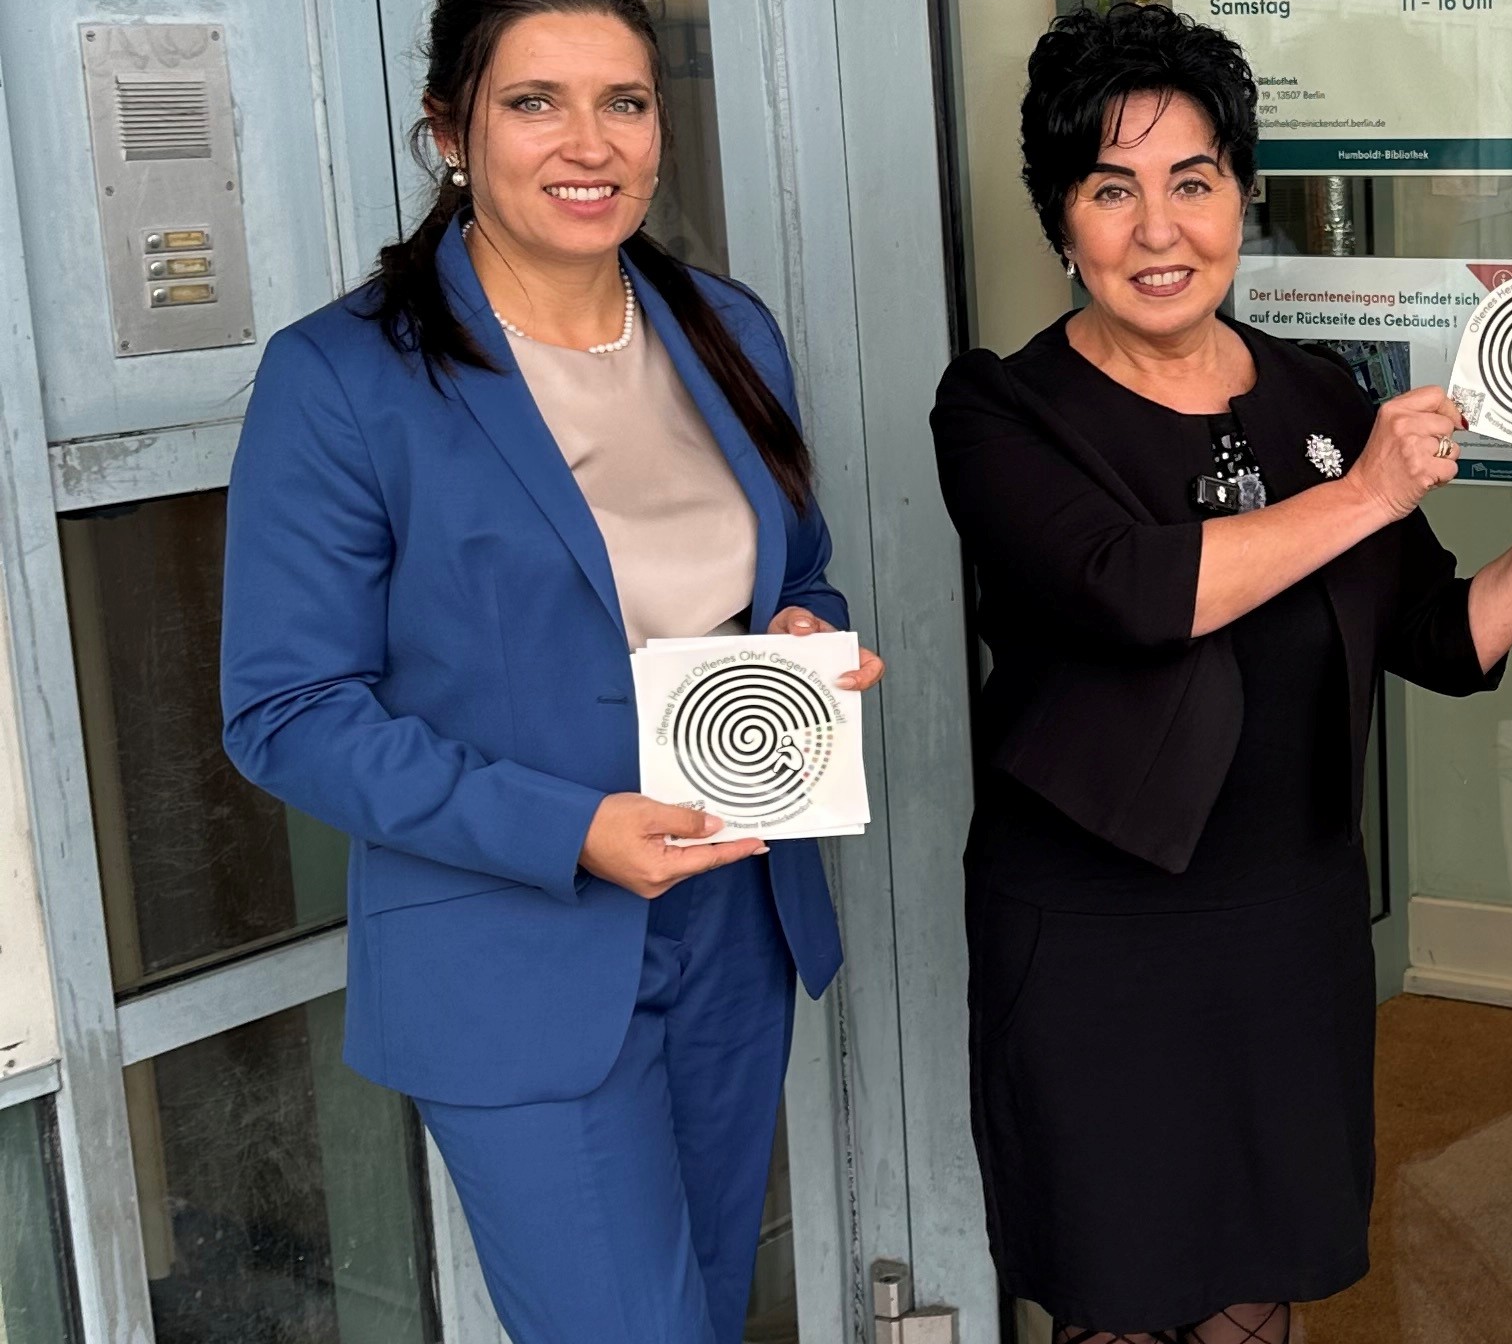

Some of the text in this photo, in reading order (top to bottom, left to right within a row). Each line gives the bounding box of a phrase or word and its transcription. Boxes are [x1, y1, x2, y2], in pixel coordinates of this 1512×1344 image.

[1276, 90, 1301, 100] 13507
[1303, 90, 1326, 99] Berlin
[1338, 149, 1429, 160] Humboldt-Bibliothek
[1249, 289, 1480, 307] Der Lieferanteneingang befindet sich
[1249, 311, 1269, 324] auf
[1272, 311, 1294, 324] der
[1296, 311, 1355, 326] Rückseite
[1358, 312, 1381, 326] des
[1384, 314, 1450, 328] Gebäudes
[1469, 297, 1498, 333] Offenes
[655, 702, 675, 746] Offenes
[668, 674, 694, 701] Herz!
[692, 654, 736, 677] Offenes
[769, 652, 807, 674] Gegen
[807, 670, 847, 725] Einsamkeit!
